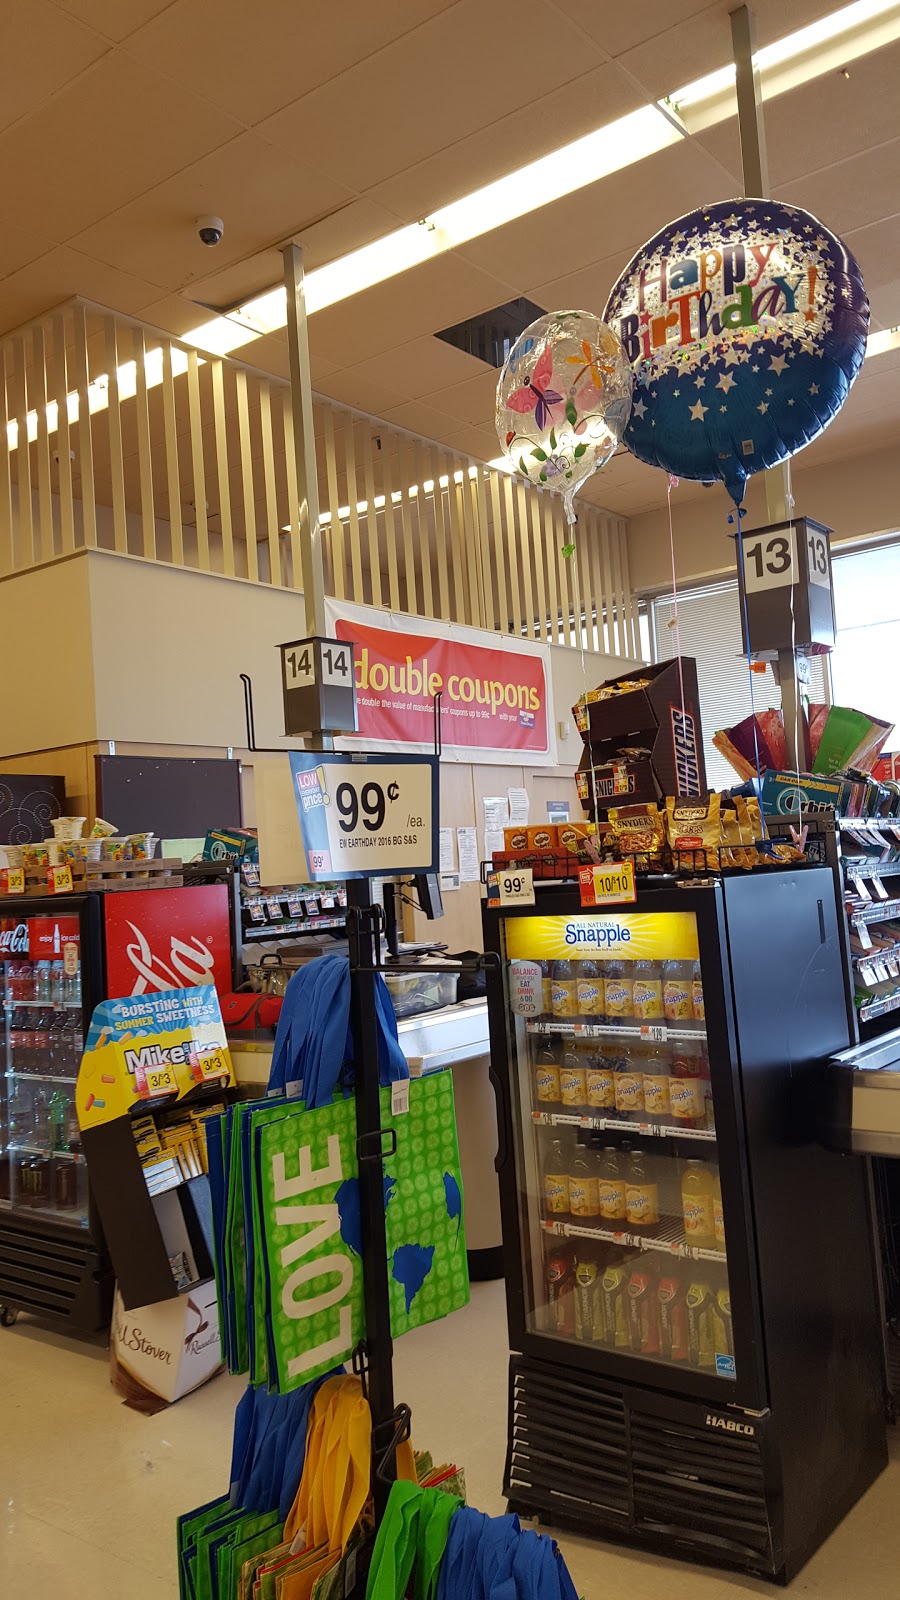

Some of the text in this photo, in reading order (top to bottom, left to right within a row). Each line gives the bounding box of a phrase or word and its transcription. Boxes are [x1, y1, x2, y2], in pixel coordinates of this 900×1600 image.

[638, 242, 779, 312] Happy
[746, 538, 792, 578] 13
[808, 536, 827, 574] 13
[287, 650, 312, 678] 14
[322, 649, 348, 676] 14
[354, 649, 541, 714] double coupons
[382, 699, 392, 708] the
[298, 773, 318, 788] LOW
[336, 781, 400, 832] 99¢
[348, 837, 377, 848] EARTHDAY
[378, 836, 392, 846] 2016
[392, 835, 402, 845] BG
[403, 834, 418, 844] S&S
[504, 877, 525, 894] 99¢
[565, 924, 631, 947] Snapple
[552, 990, 568, 1000] apple
[114, 1004, 215, 1031] SUMMER SWEETNESS
[124, 1045, 185, 1074] Mike
[272, 1133, 354, 1379] LOVE
[706, 1414, 755, 1436] HABCO
